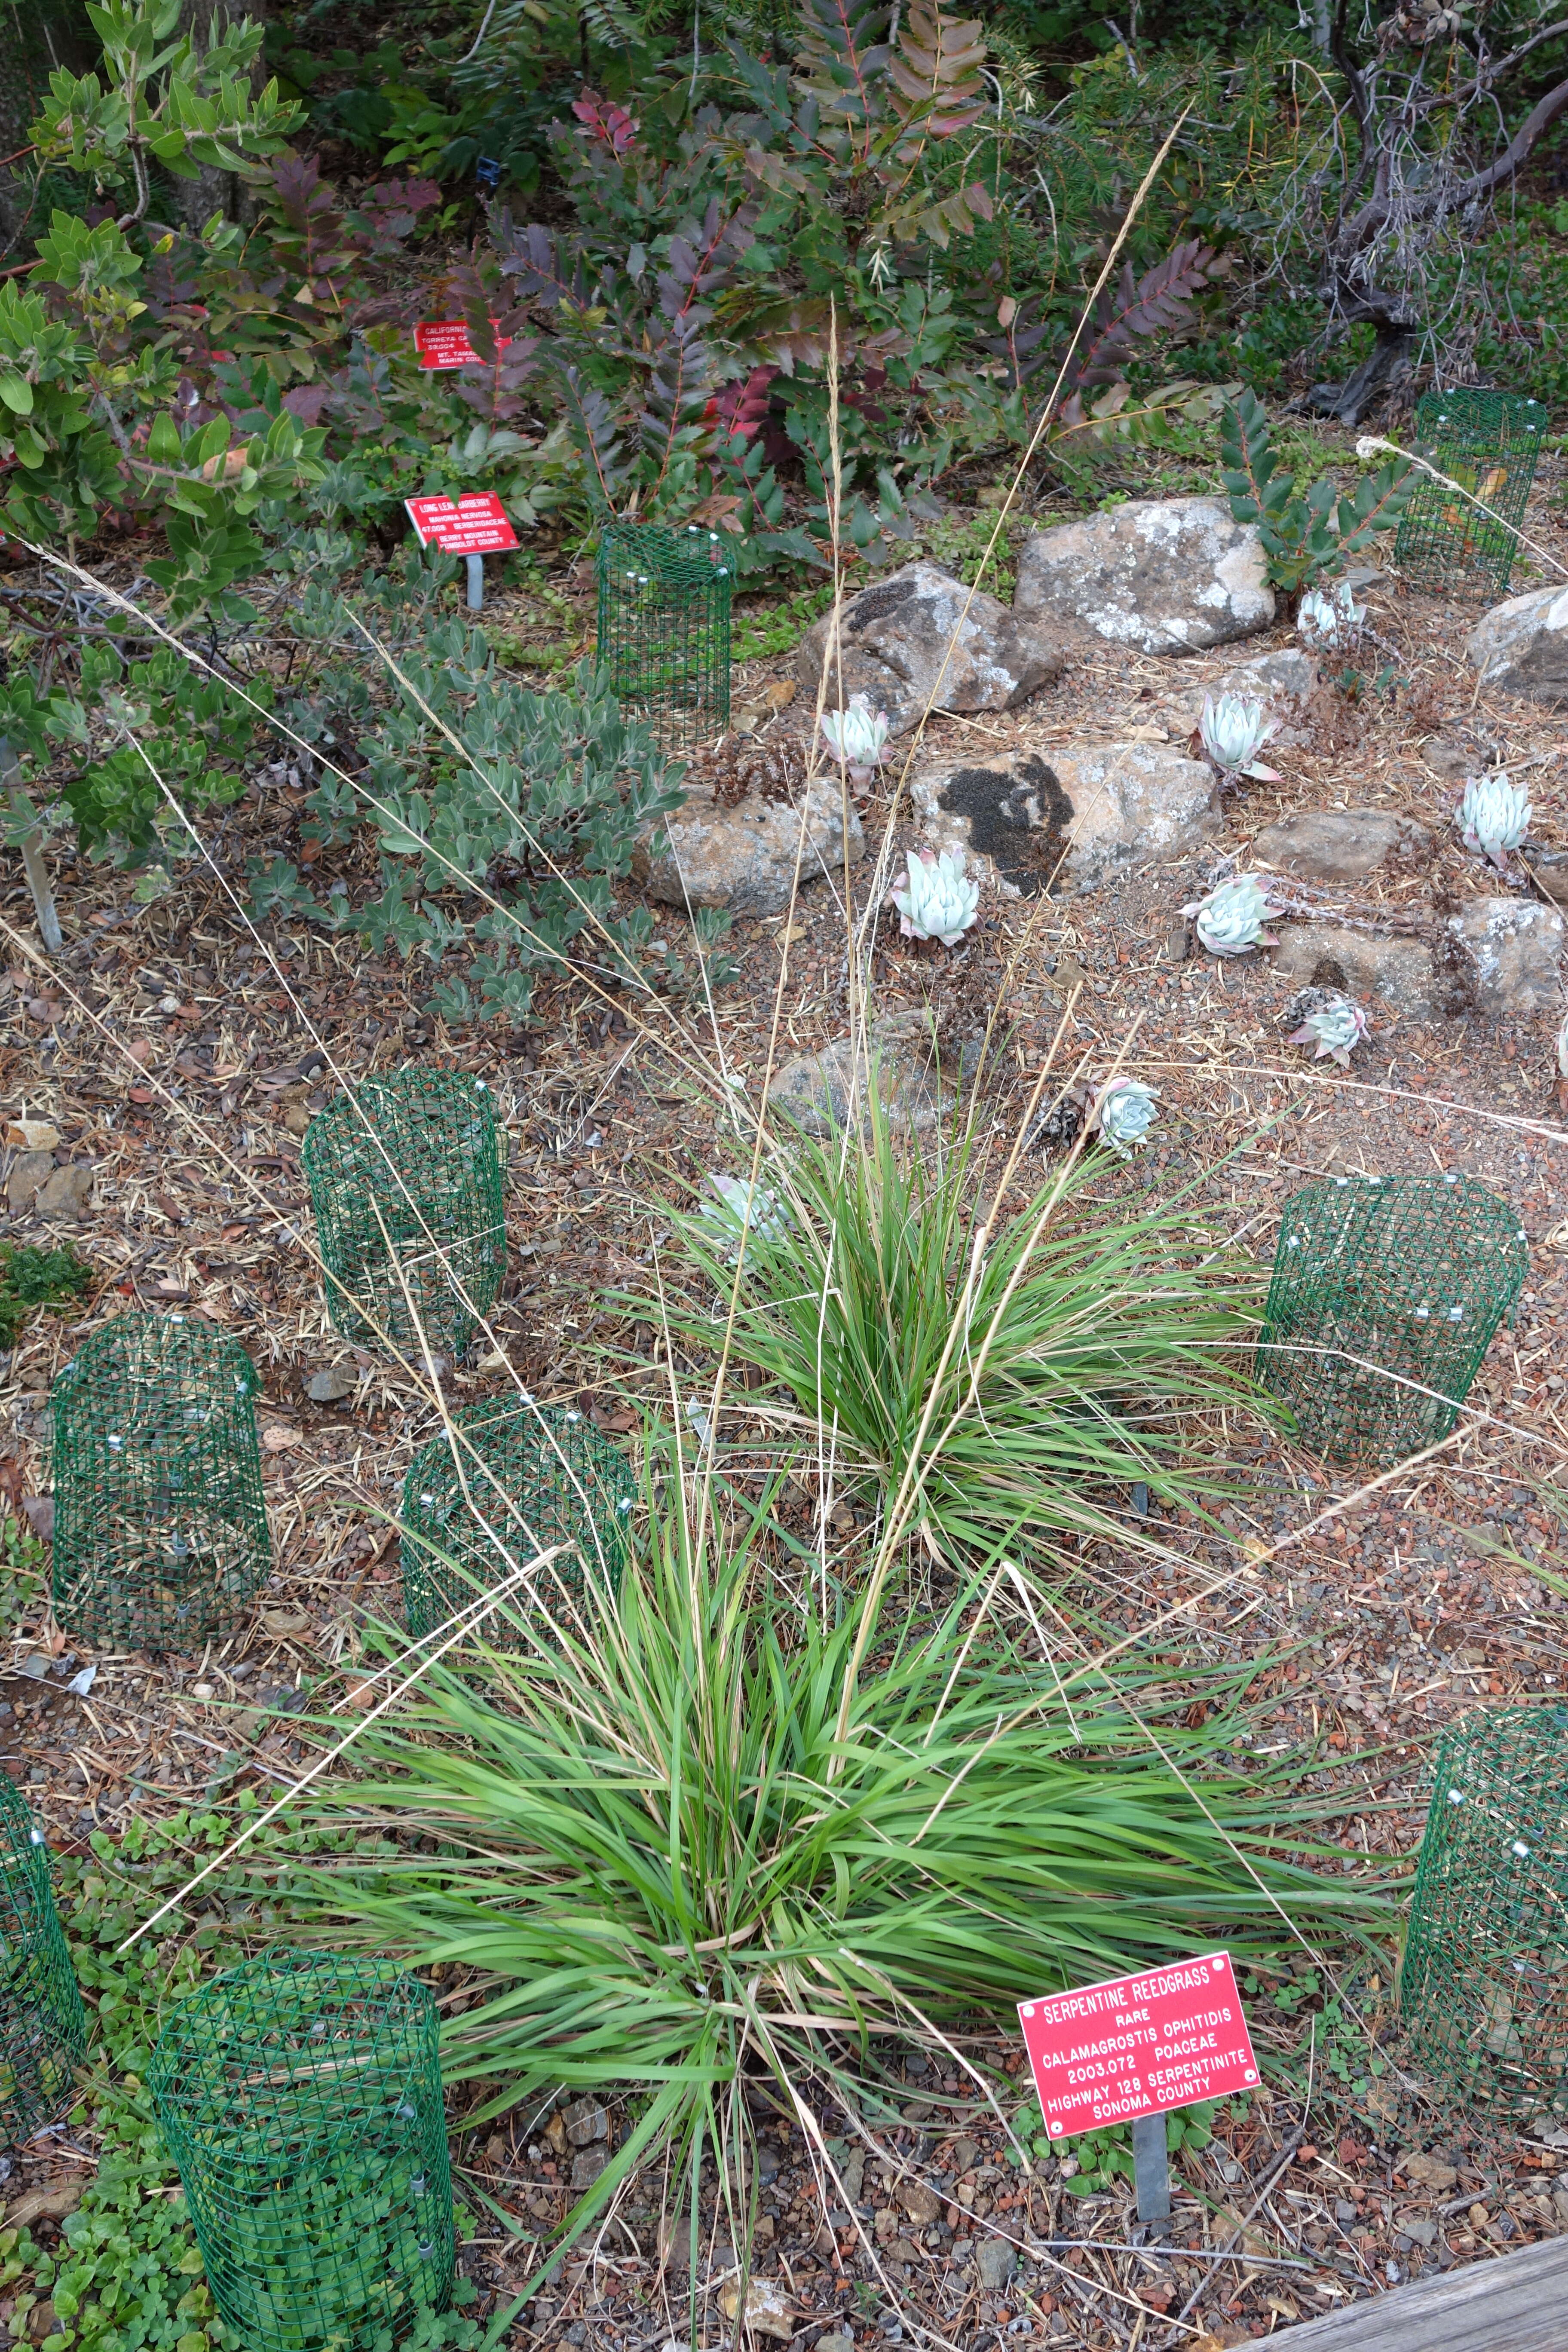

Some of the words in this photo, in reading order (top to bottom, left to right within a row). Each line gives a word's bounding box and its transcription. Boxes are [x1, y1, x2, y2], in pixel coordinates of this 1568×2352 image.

[419, 503, 438, 513] LONG
[428, 514, 460, 523] MAHONIA
[461, 511, 493, 519] NERVOSA
[453, 518, 507, 529] BERBERIDACEAE
[463, 530, 499, 539] MOUNTAIN
[477, 537, 504, 545] COUNTY
[1044, 1987, 1128, 2024] SERPENTINE
[1132, 1966, 1210, 2002] REEDGRASS
[1115, 2008, 1150, 2027] RARE
[1043, 2027, 1157, 2068] CALAMAGROSTIS
[1164, 2008, 1231, 2037] OPHITIDIS
[1068, 2055, 1136, 2084] 2003.072
[1155, 2033, 1217, 2061] POACEAE
[1047, 2085, 1109, 2113] HIGHWAY
[1117, 2077, 1141, 2095] 128
[1148, 2049, 1247, 2087] SERPENTINITE
[1093, 2093, 1152, 2119] SONOMA
[1157, 2076, 1209, 2102] COUNTY
